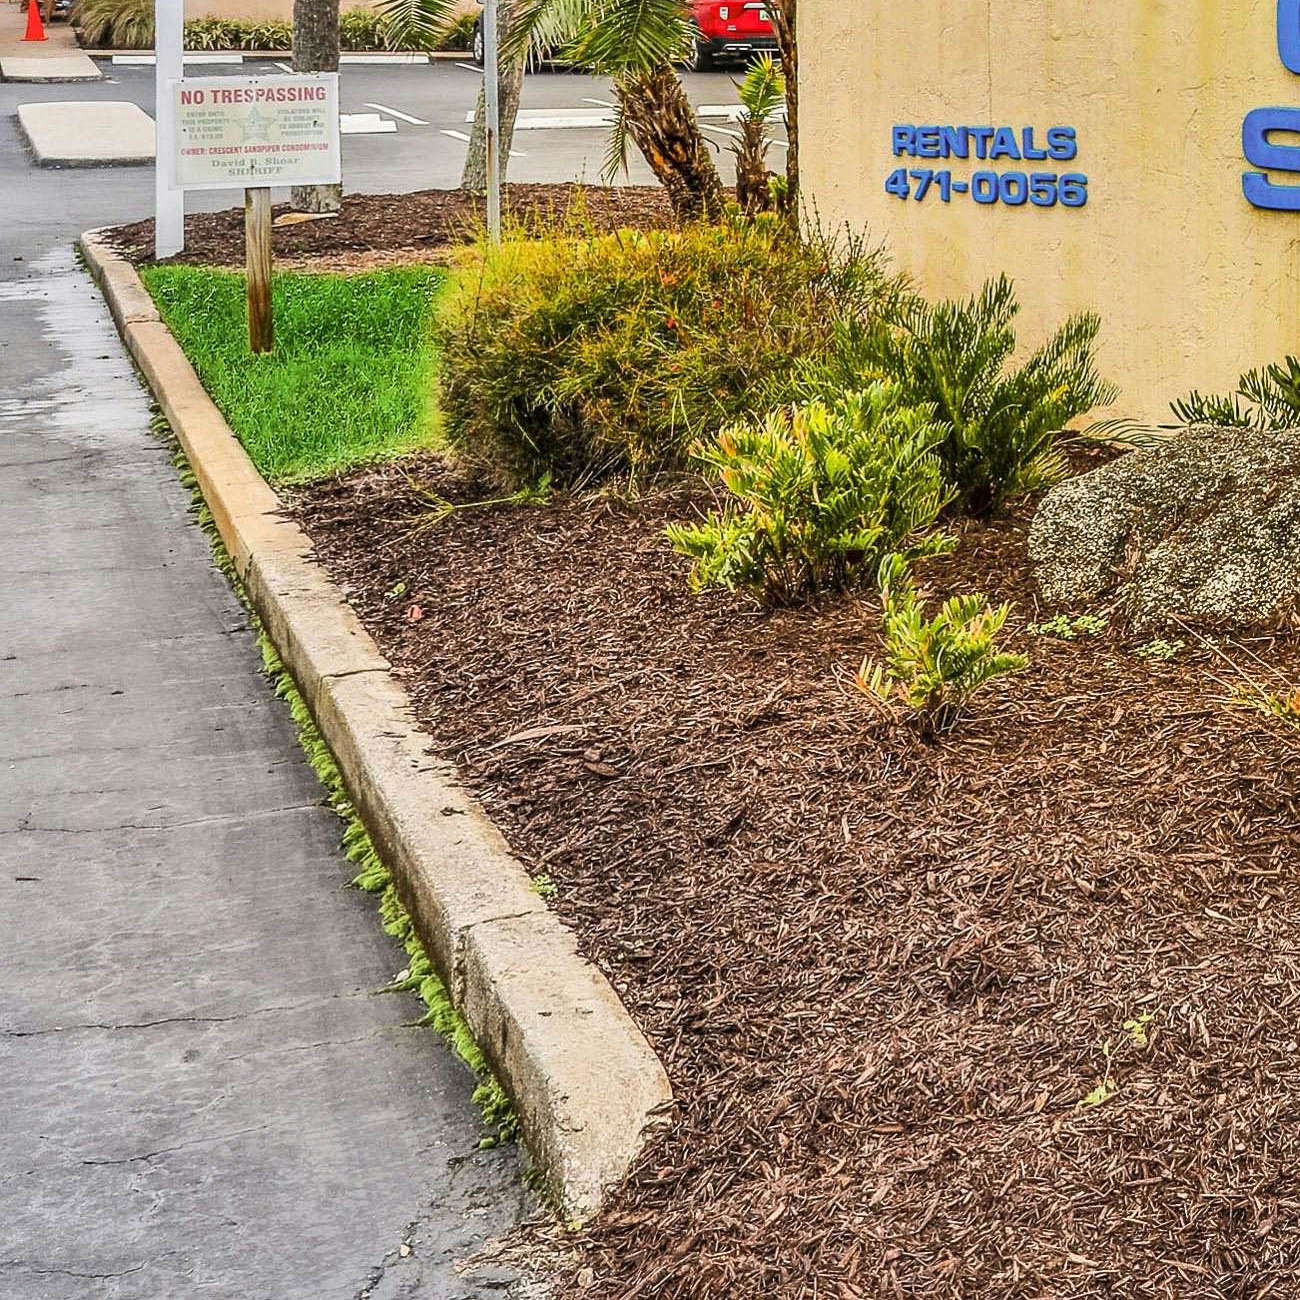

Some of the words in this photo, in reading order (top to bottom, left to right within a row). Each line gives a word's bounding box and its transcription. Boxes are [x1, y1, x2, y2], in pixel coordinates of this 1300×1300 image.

[181, 90, 205, 105] NO
[210, 86, 327, 104] TRESPASSING
[208, 146, 242, 155] CRESCENT
[244, 144, 280, 154] SANDPIPER
[892, 124, 1078, 160] RENTALS
[212, 158, 246, 168] David
[885, 168, 1088, 207] 471-0056
